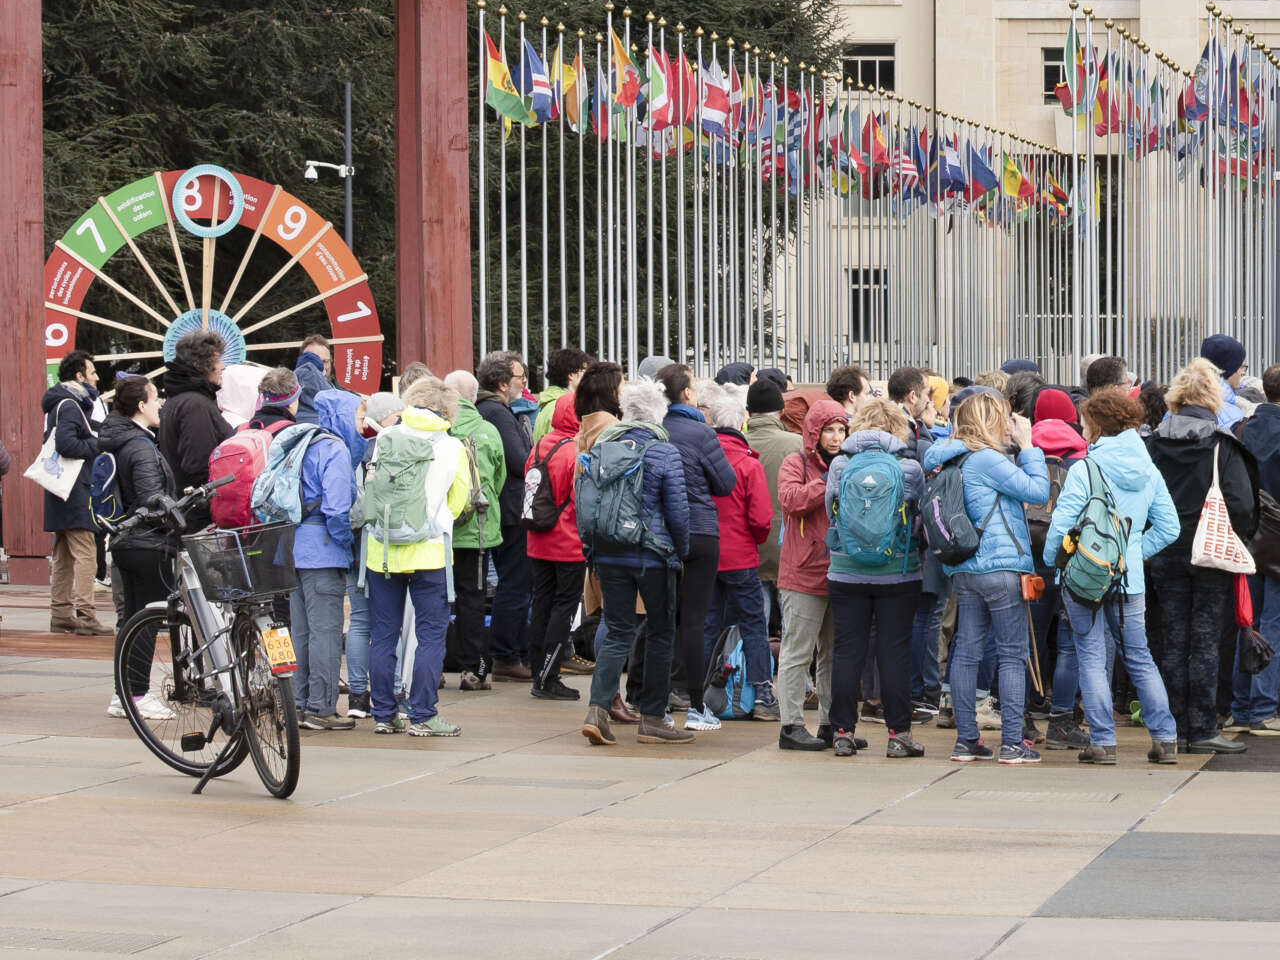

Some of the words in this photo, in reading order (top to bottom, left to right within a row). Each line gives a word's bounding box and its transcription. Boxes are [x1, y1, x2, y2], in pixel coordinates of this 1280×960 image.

[116, 190, 156, 212] acidification
[184, 177, 202, 211] 8
[132, 204, 145, 213] des
[276, 205, 308, 241] 9
[75, 217, 107, 254] 7
[337, 301, 372, 322] 1
[344, 348, 353, 384] biodiversité
[355, 359, 361, 368] de
[361, 355, 370, 381] érosion
[267, 638, 290, 650] 636
